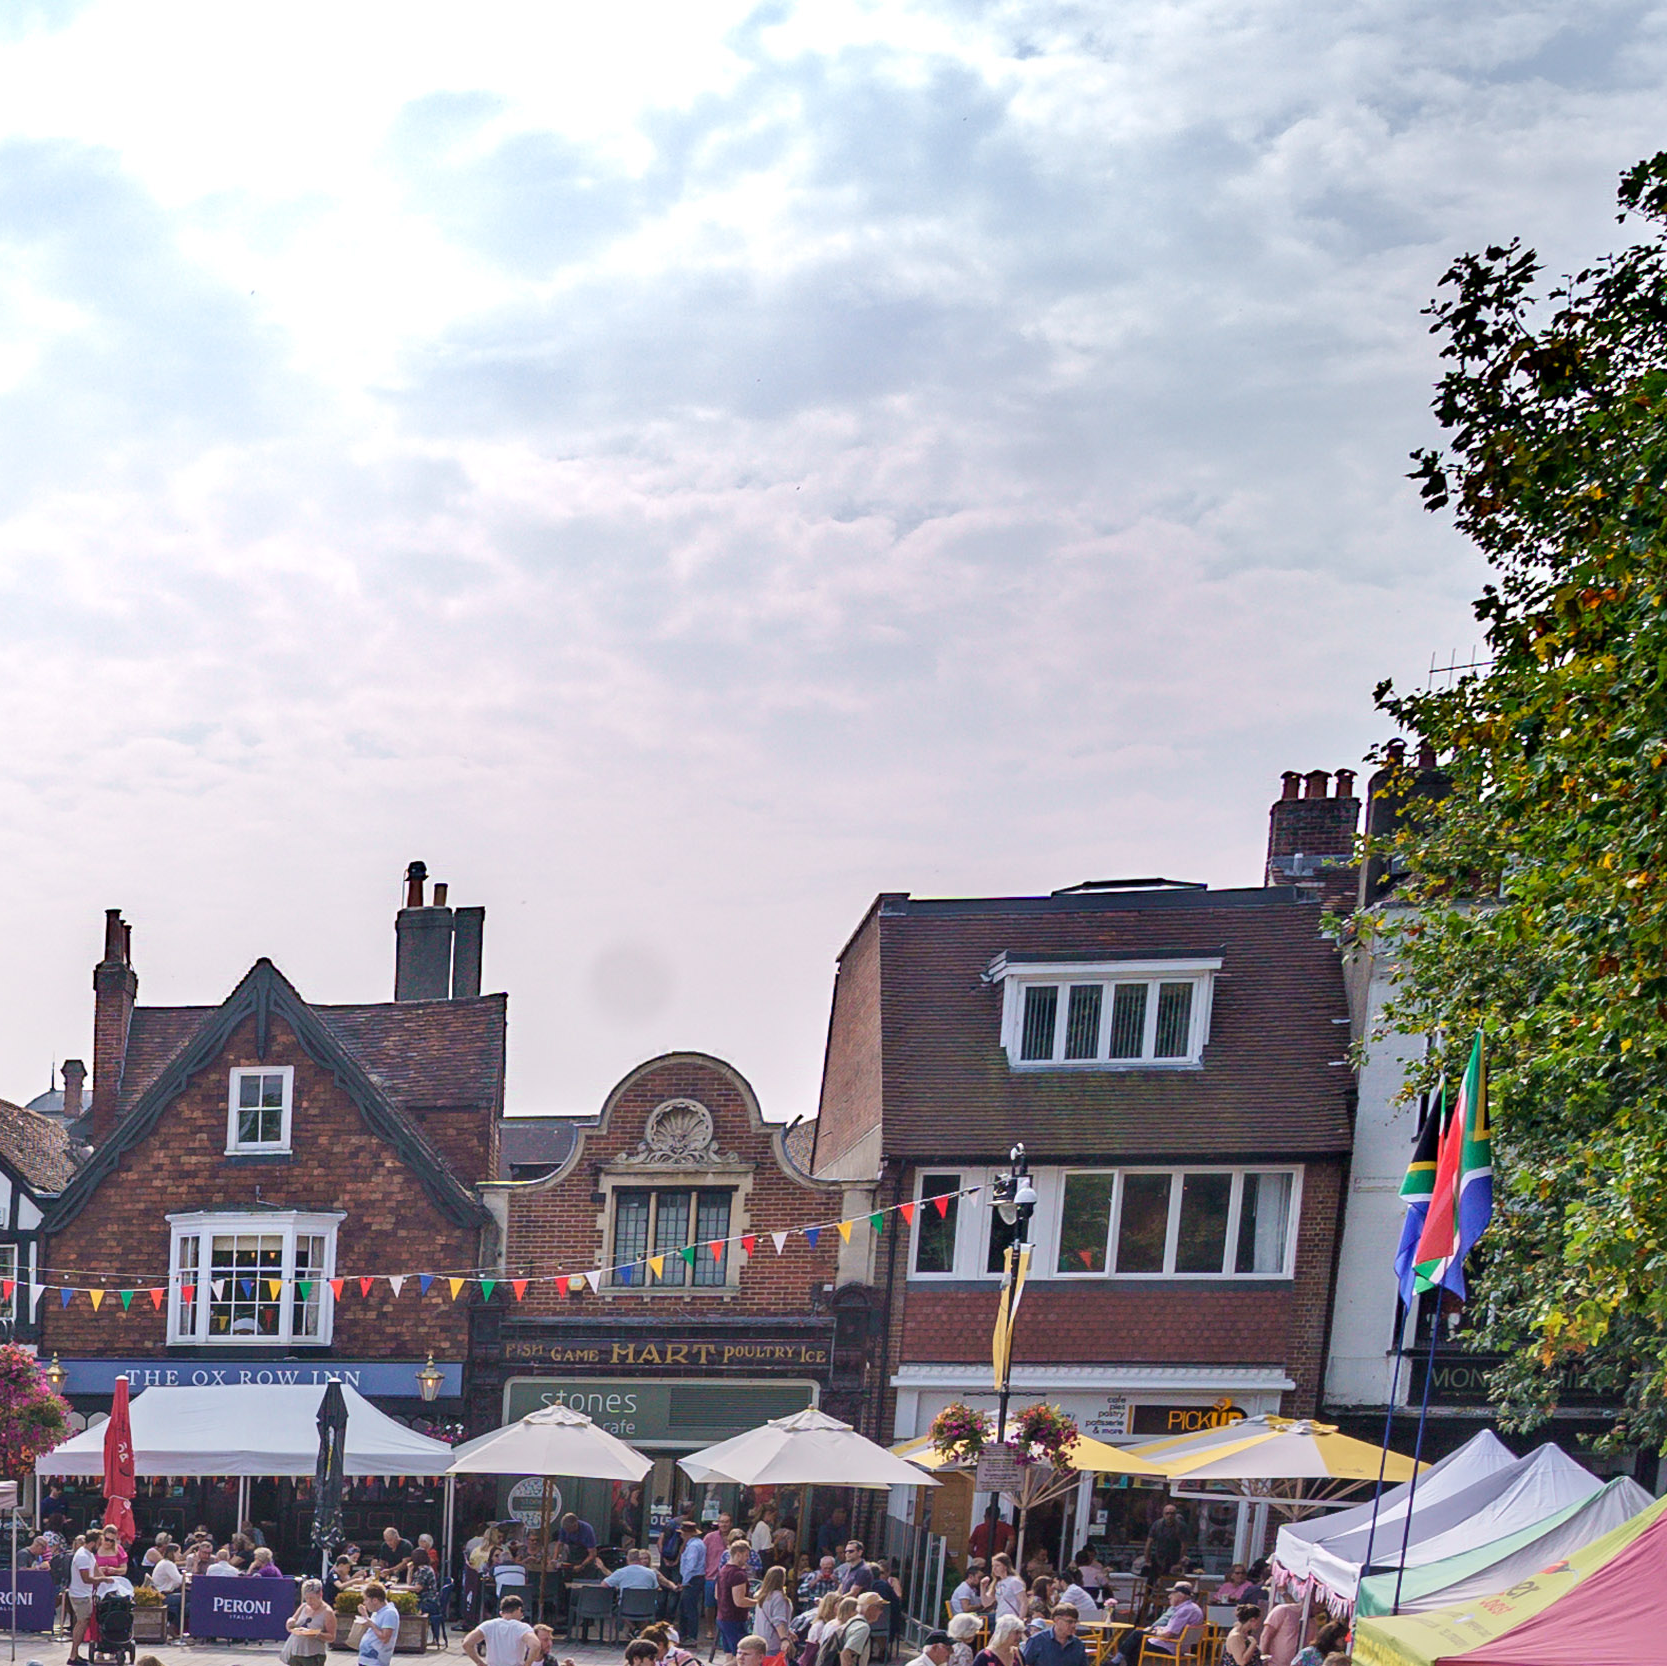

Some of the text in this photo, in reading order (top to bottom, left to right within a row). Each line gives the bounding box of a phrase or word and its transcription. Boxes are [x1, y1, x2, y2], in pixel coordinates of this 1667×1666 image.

[505, 1343, 827, 1364] FISH GAME HART POULTRY ICE
[125, 1369, 361, 1387] THE OX ROW INN
[540, 1389, 638, 1413] stones
[1107, 1396, 1126, 1404] cafe
[1098, 1410, 1125, 1418] pastry
[603, 1421, 636, 1435] cafe
[1086, 1419, 1124, 1427] patisserie
[213, 1597, 272, 1615] PERONI
